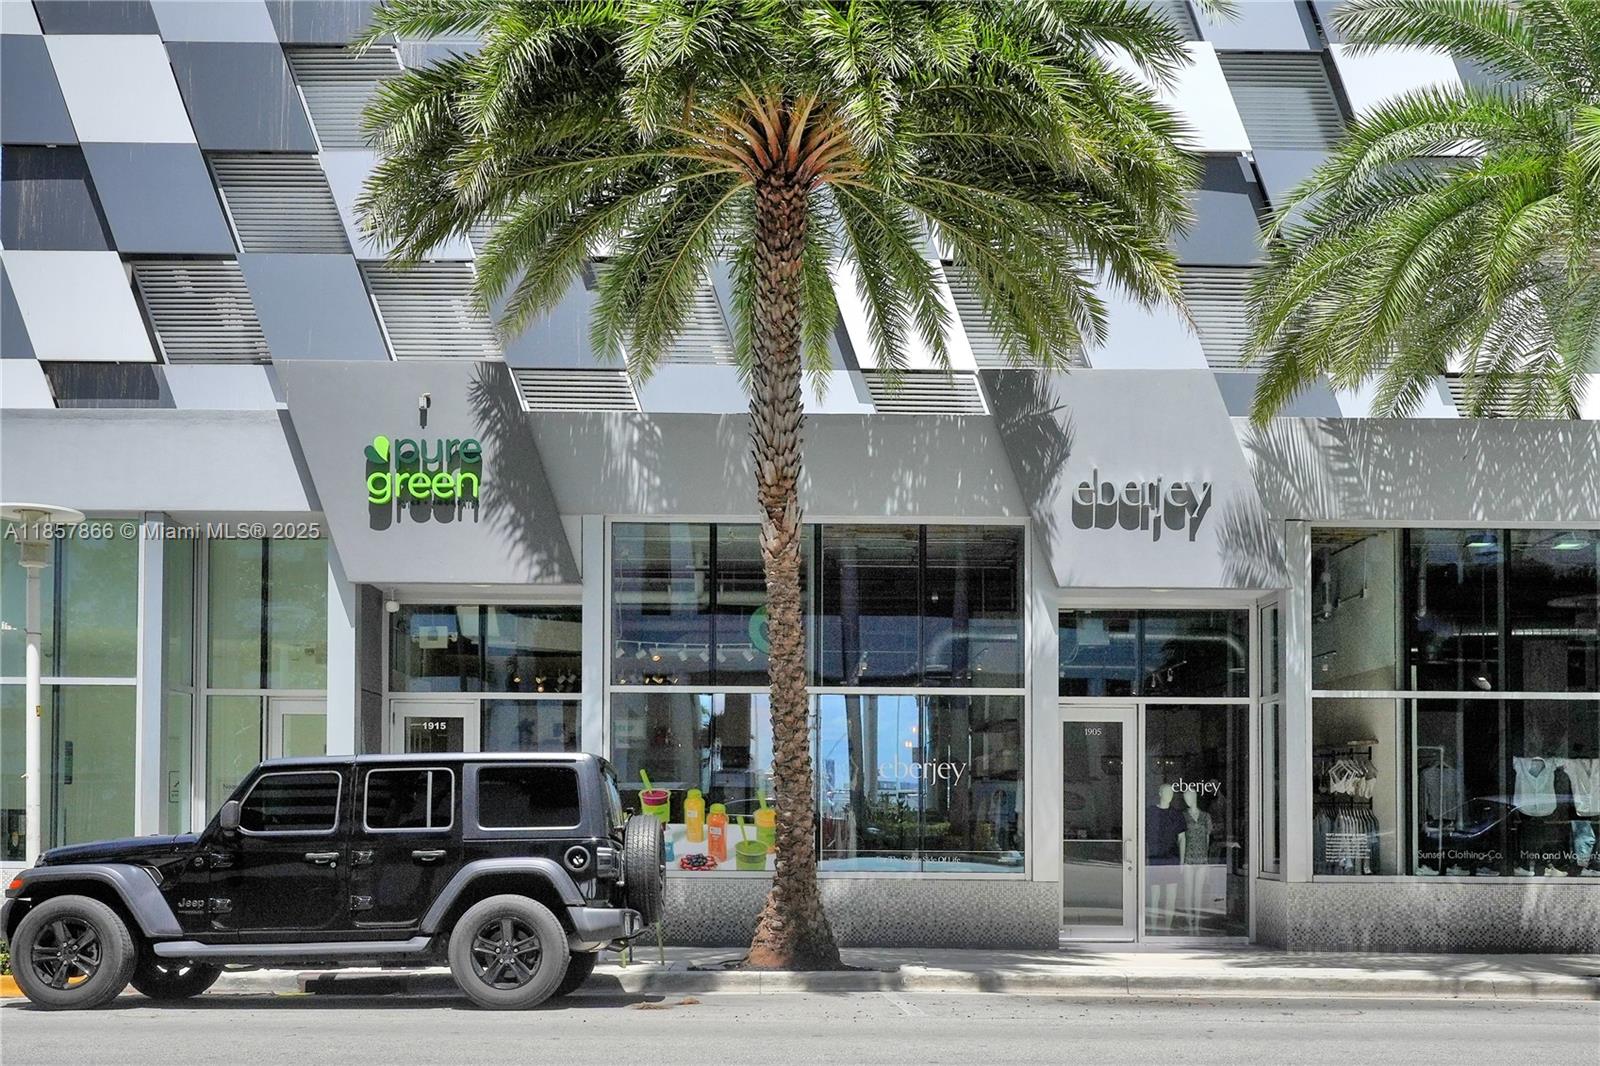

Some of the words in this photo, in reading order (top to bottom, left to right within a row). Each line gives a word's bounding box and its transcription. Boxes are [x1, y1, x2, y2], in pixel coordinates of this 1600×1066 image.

[395, 438, 483, 470] pure
[366, 472, 479, 504] green
[1072, 467, 1212, 522] eberjey
[422, 721, 447, 731] 1915
[1085, 727, 1102, 736] 1905
[879, 754, 967, 786] eberjey
[1171, 777, 1222, 796] eberjey
[1417, 849, 1446, 859] Sunset
[1520, 850, 1540, 860] Men
[1542, 850, 1561, 860] and
[1562, 850, 1600, 860] Won's
[177, 897, 205, 909] Jeep
